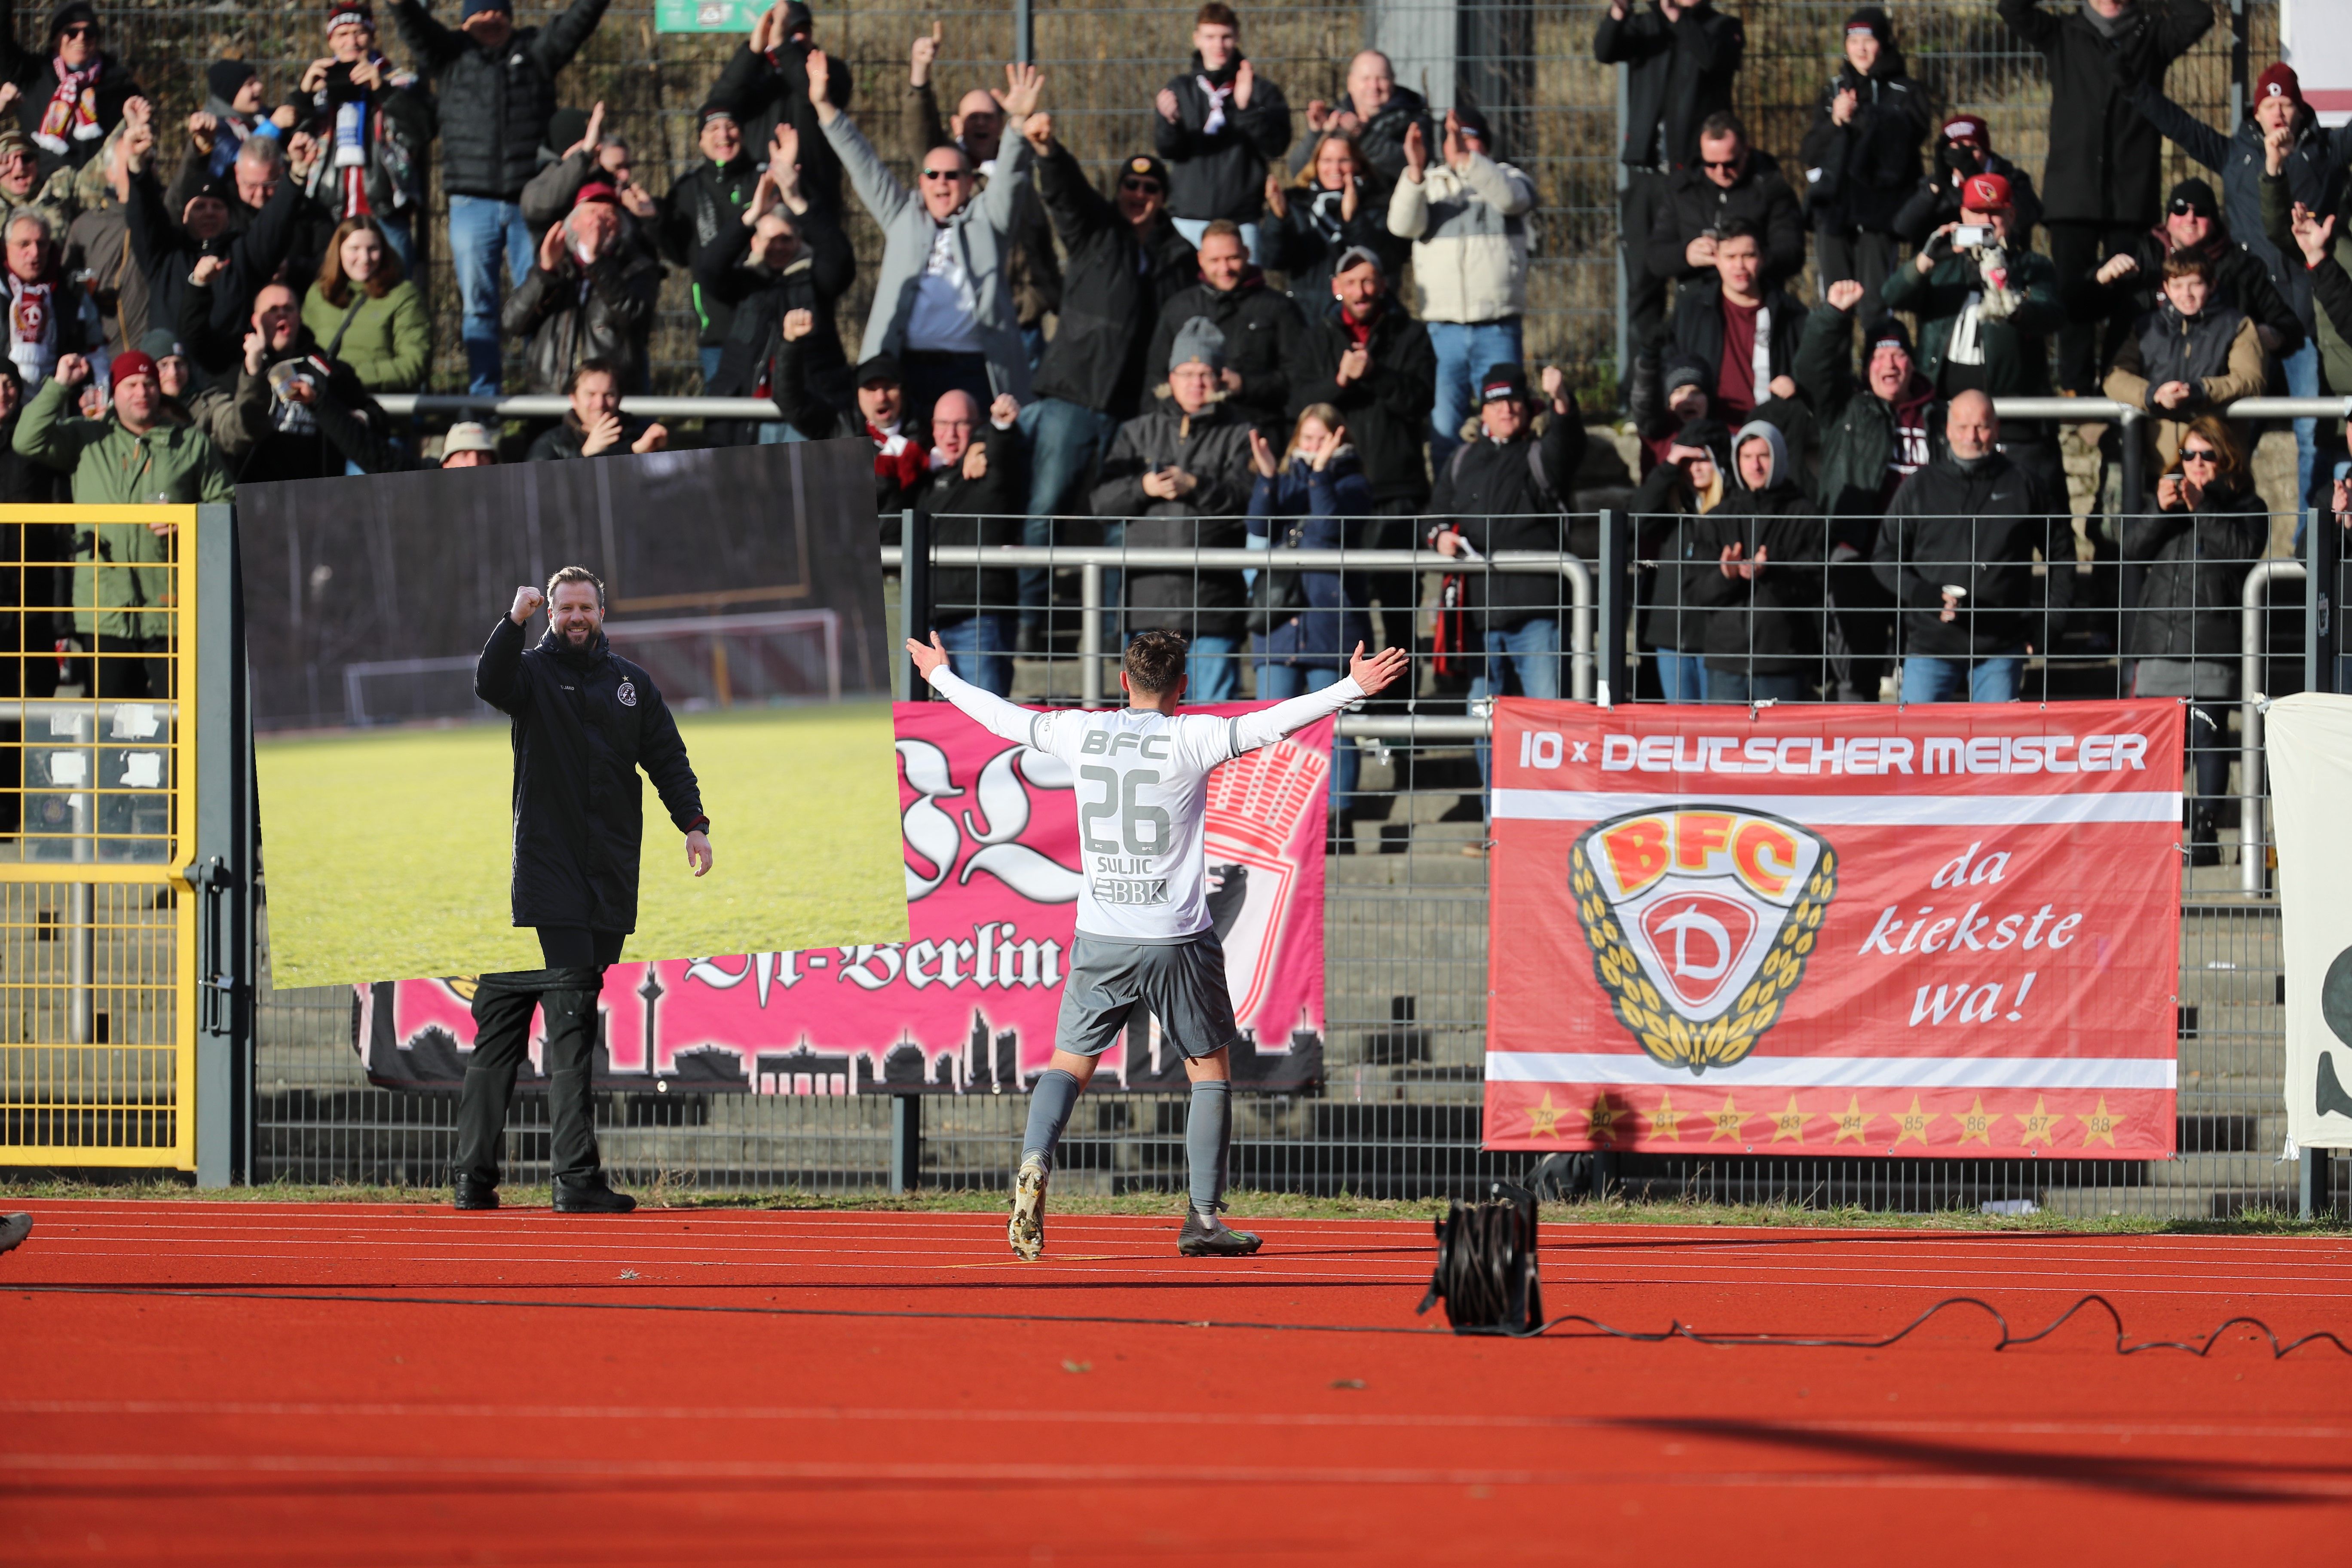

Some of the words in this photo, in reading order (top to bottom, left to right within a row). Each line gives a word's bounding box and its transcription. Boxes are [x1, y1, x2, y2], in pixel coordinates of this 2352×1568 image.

[1080, 730, 1171, 760] BFC
[1519, 731, 1563, 770] 10
[1601, 733, 1915, 775] DEUTSCHER
[1922, 733, 2148, 775] MEISTER
[1080, 764, 1171, 856] 26
[1097, 856, 1153, 875] SULJIC
[1601, 812, 1798, 897] BFC
[1931, 840, 2012, 890] da
[1112, 880, 1168, 904] BBK
[1653, 903, 1731, 980] D
[1857, 901, 2083, 956] kiekste
[1908, 971, 2037, 1028] wa!
[1536, 1111, 1554, 1125] 79
[1591, 1112, 1611, 1127] 80
[1655, 1112, 1675, 1127] 81
[1718, 1114, 1739, 1130] 82
[1780, 1115, 1801, 1130] 83
[1842, 1116, 1862, 1130] 84
[1904, 1116, 1924, 1131] 85
[1966, 1116, 1987, 1132] 86
[2028, 1116, 2050, 1132] 87
[2091, 1117, 2111, 1133] 88
